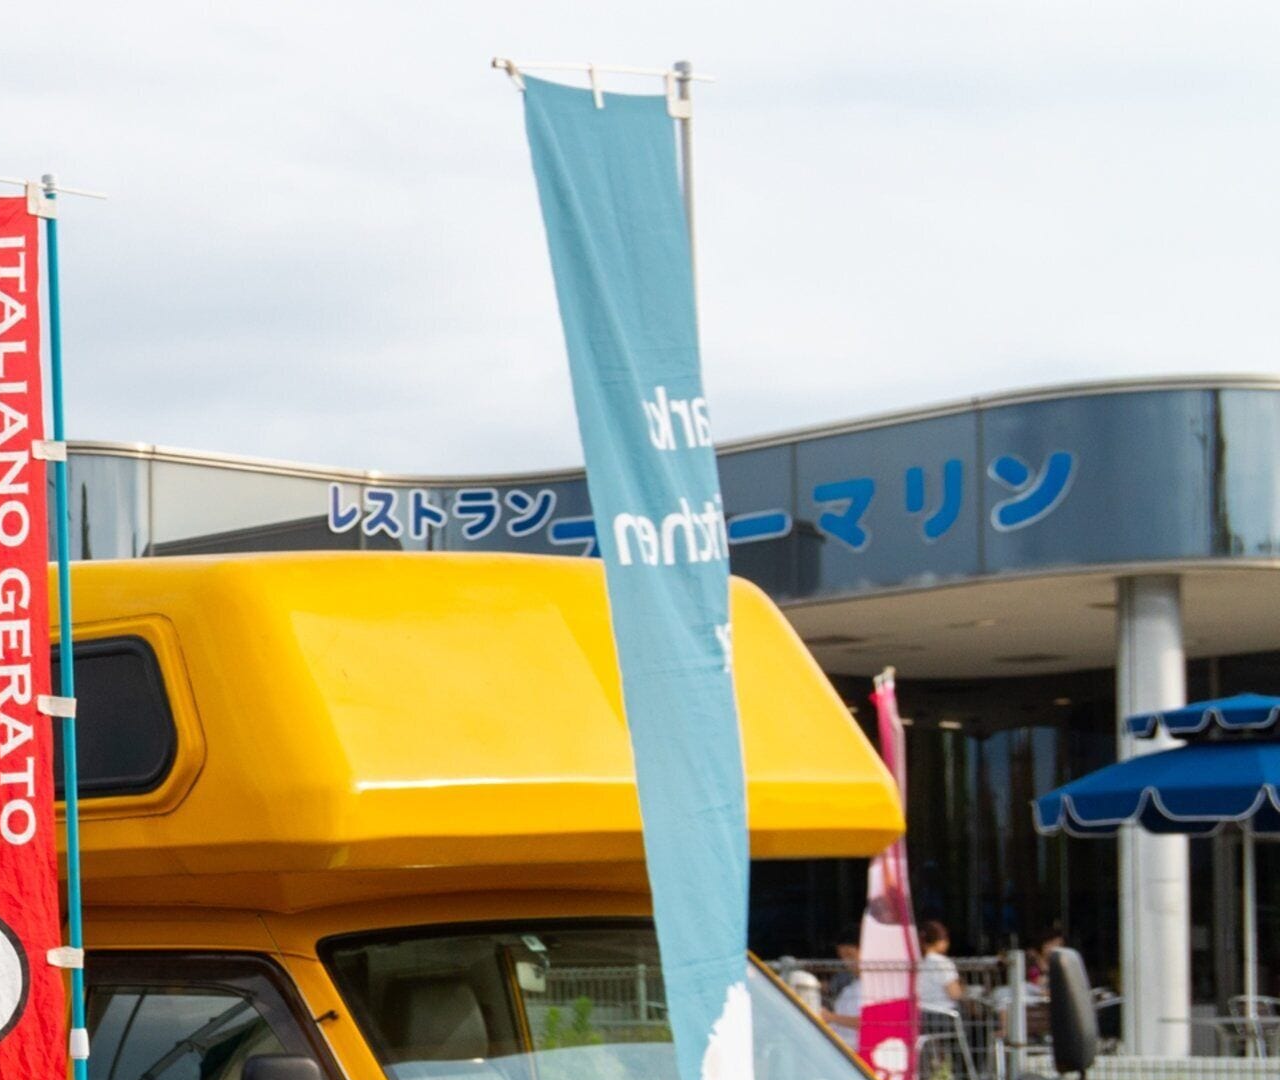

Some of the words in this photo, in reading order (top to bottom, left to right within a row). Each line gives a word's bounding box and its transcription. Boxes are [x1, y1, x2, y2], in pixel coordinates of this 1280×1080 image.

[328, 483, 558, 540] レストラン
[549, 451, 1075, 558] ーマリン
